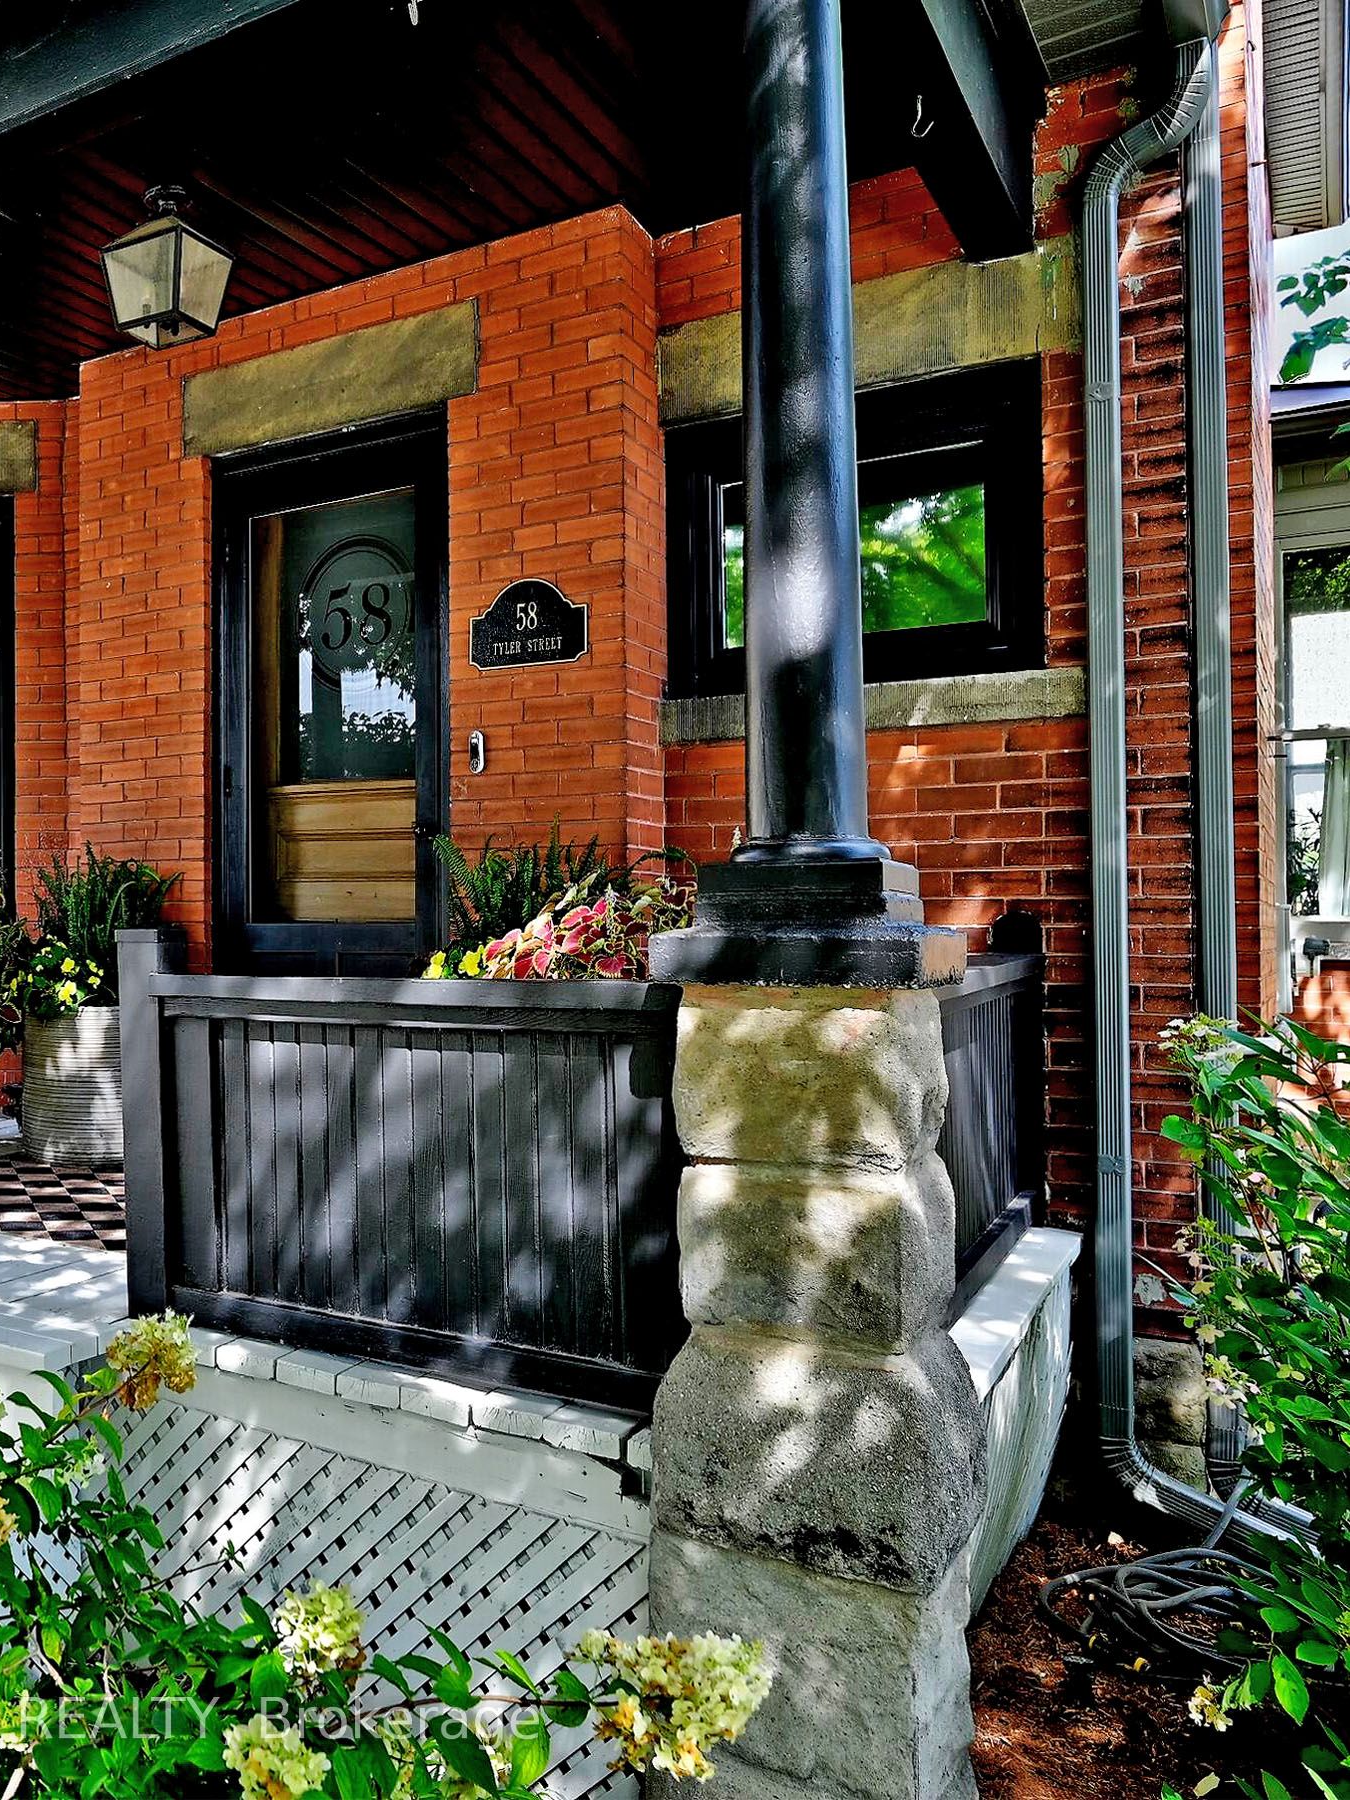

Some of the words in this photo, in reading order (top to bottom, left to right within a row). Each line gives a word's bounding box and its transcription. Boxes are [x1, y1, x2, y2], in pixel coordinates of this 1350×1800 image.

[321, 582, 393, 651] 58
[516, 601, 538, 631] 58
[493, 640, 521, 656] TYLER
[527, 636, 563, 653] STREET
